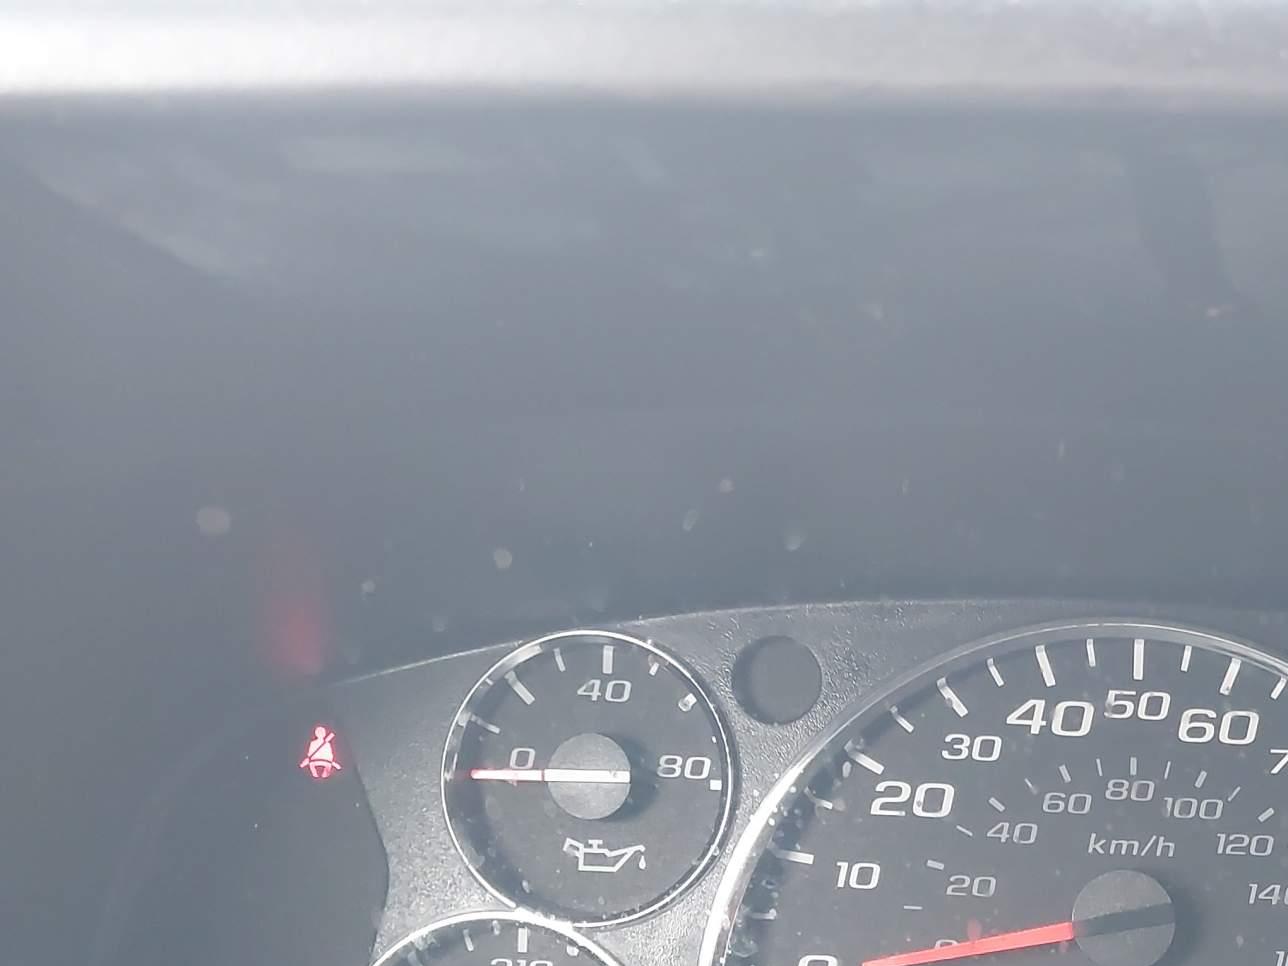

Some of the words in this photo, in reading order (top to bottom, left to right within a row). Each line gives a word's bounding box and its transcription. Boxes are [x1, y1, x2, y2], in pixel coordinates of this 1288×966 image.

[577, 679, 631, 703] 40
[1006, 699, 1094, 737] 40
[1104, 690, 1171, 721] 50
[1177, 709, 1260, 745] 60
[508, 746, 537, 771] 0
[941, 733, 1002, 762] 30
[657, 755, 712, 780] 80
[870, 780, 955, 819] 20
[1042, 791, 1092, 815] 60
[1104, 779, 1155, 802] 80
[1164, 796, 1224, 820] 100
[986, 821, 1038, 845] 40
[1087, 833, 1176, 858] km/h
[1216, 833, 1275, 858] 120
[836, 862, 881, 890] 10
[945, 875, 996, 898] 20
